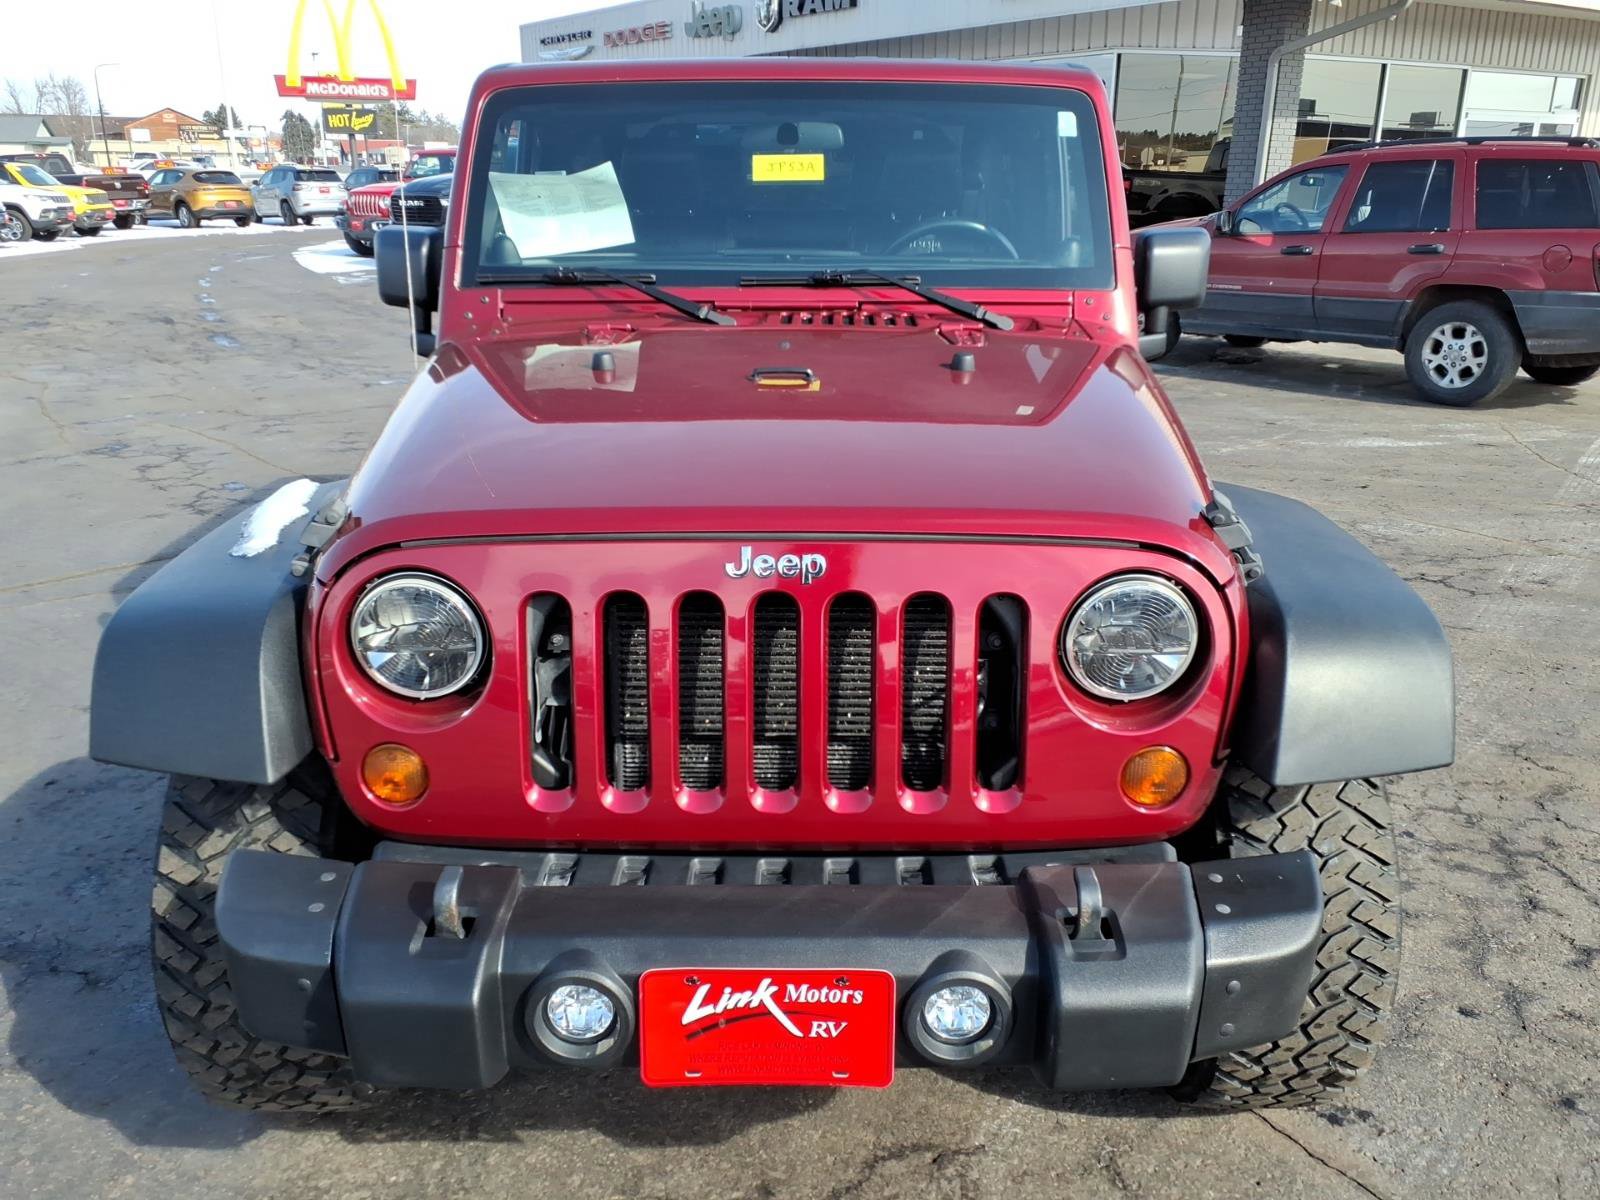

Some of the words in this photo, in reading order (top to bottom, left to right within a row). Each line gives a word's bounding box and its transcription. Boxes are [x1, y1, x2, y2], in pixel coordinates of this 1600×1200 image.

[603, 20, 673, 48] DODGE
[684, 0, 743, 41] Jeep
[306, 82, 389, 97] McDonald's
[327, 114, 350, 128] HOT
[725, 545, 828, 585] Jeep
[680, 977, 805, 1038] Link
[783, 983, 864, 1005] Motors
[808, 1021, 849, 1038] RV
